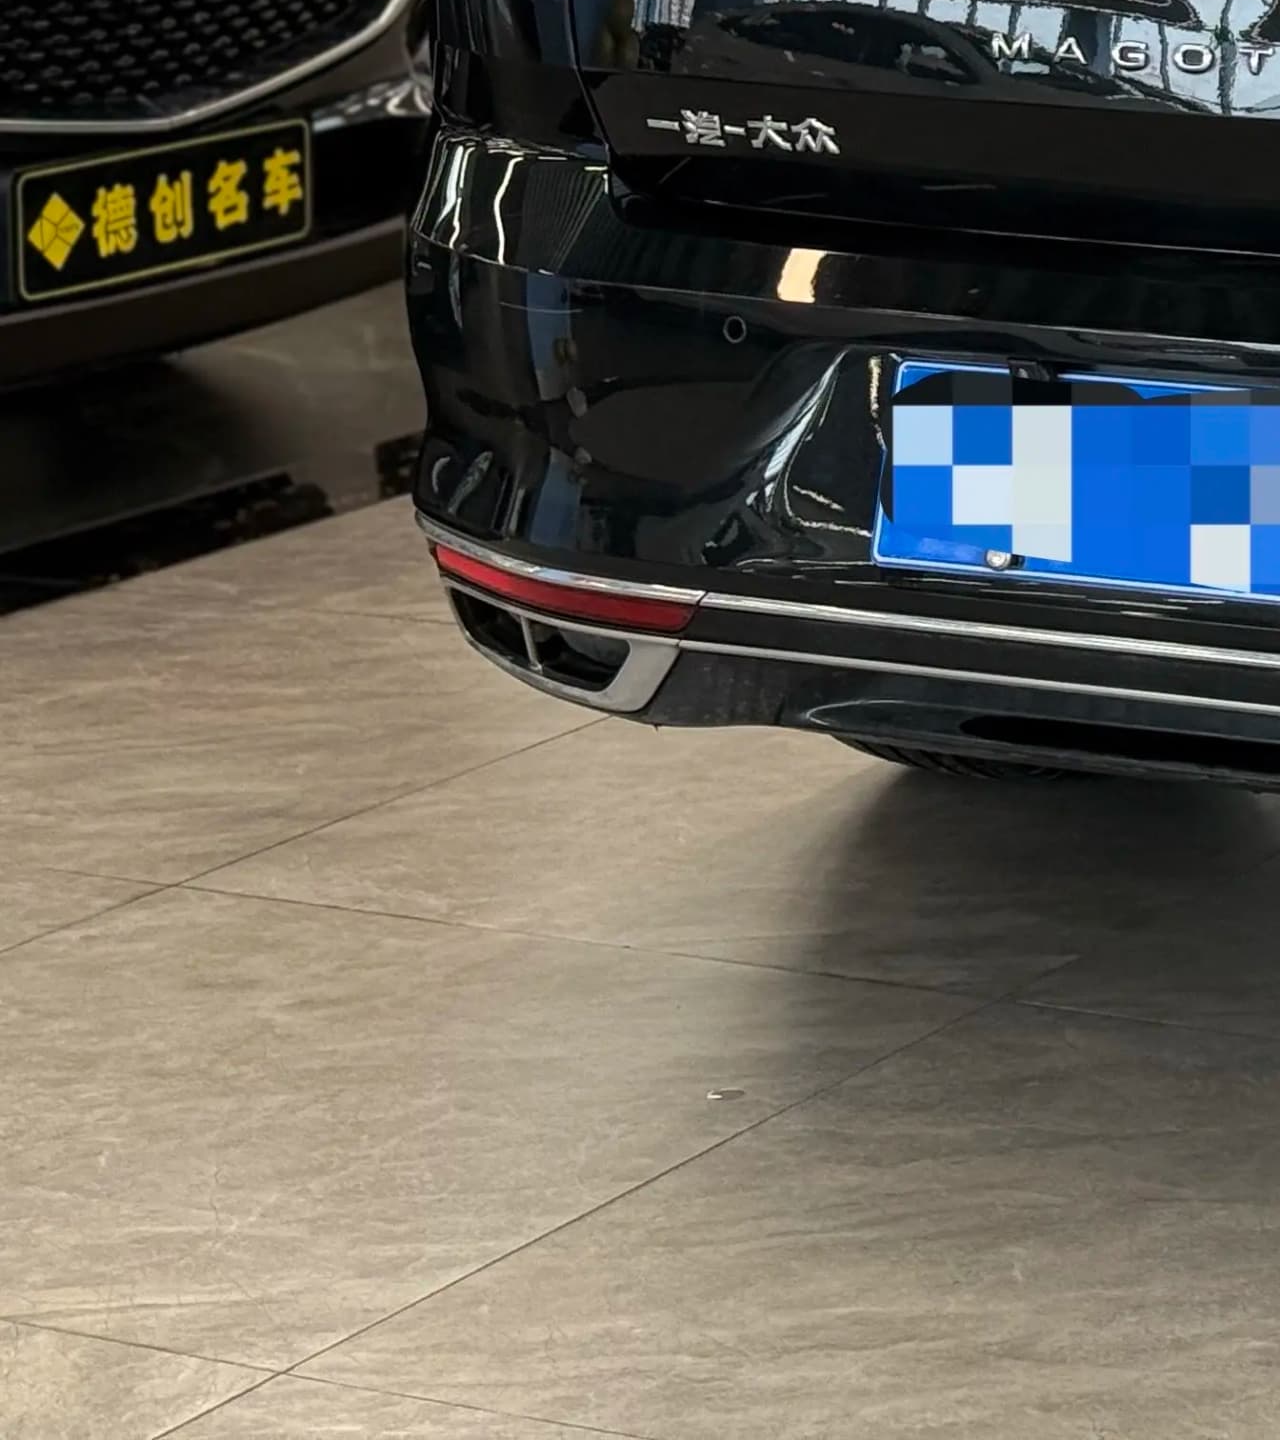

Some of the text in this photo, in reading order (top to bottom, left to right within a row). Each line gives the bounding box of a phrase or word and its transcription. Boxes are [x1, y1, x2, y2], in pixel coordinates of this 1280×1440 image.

[646, 109, 841, 155] 一汽-大众
[91, 147, 303, 258] 德创名车
